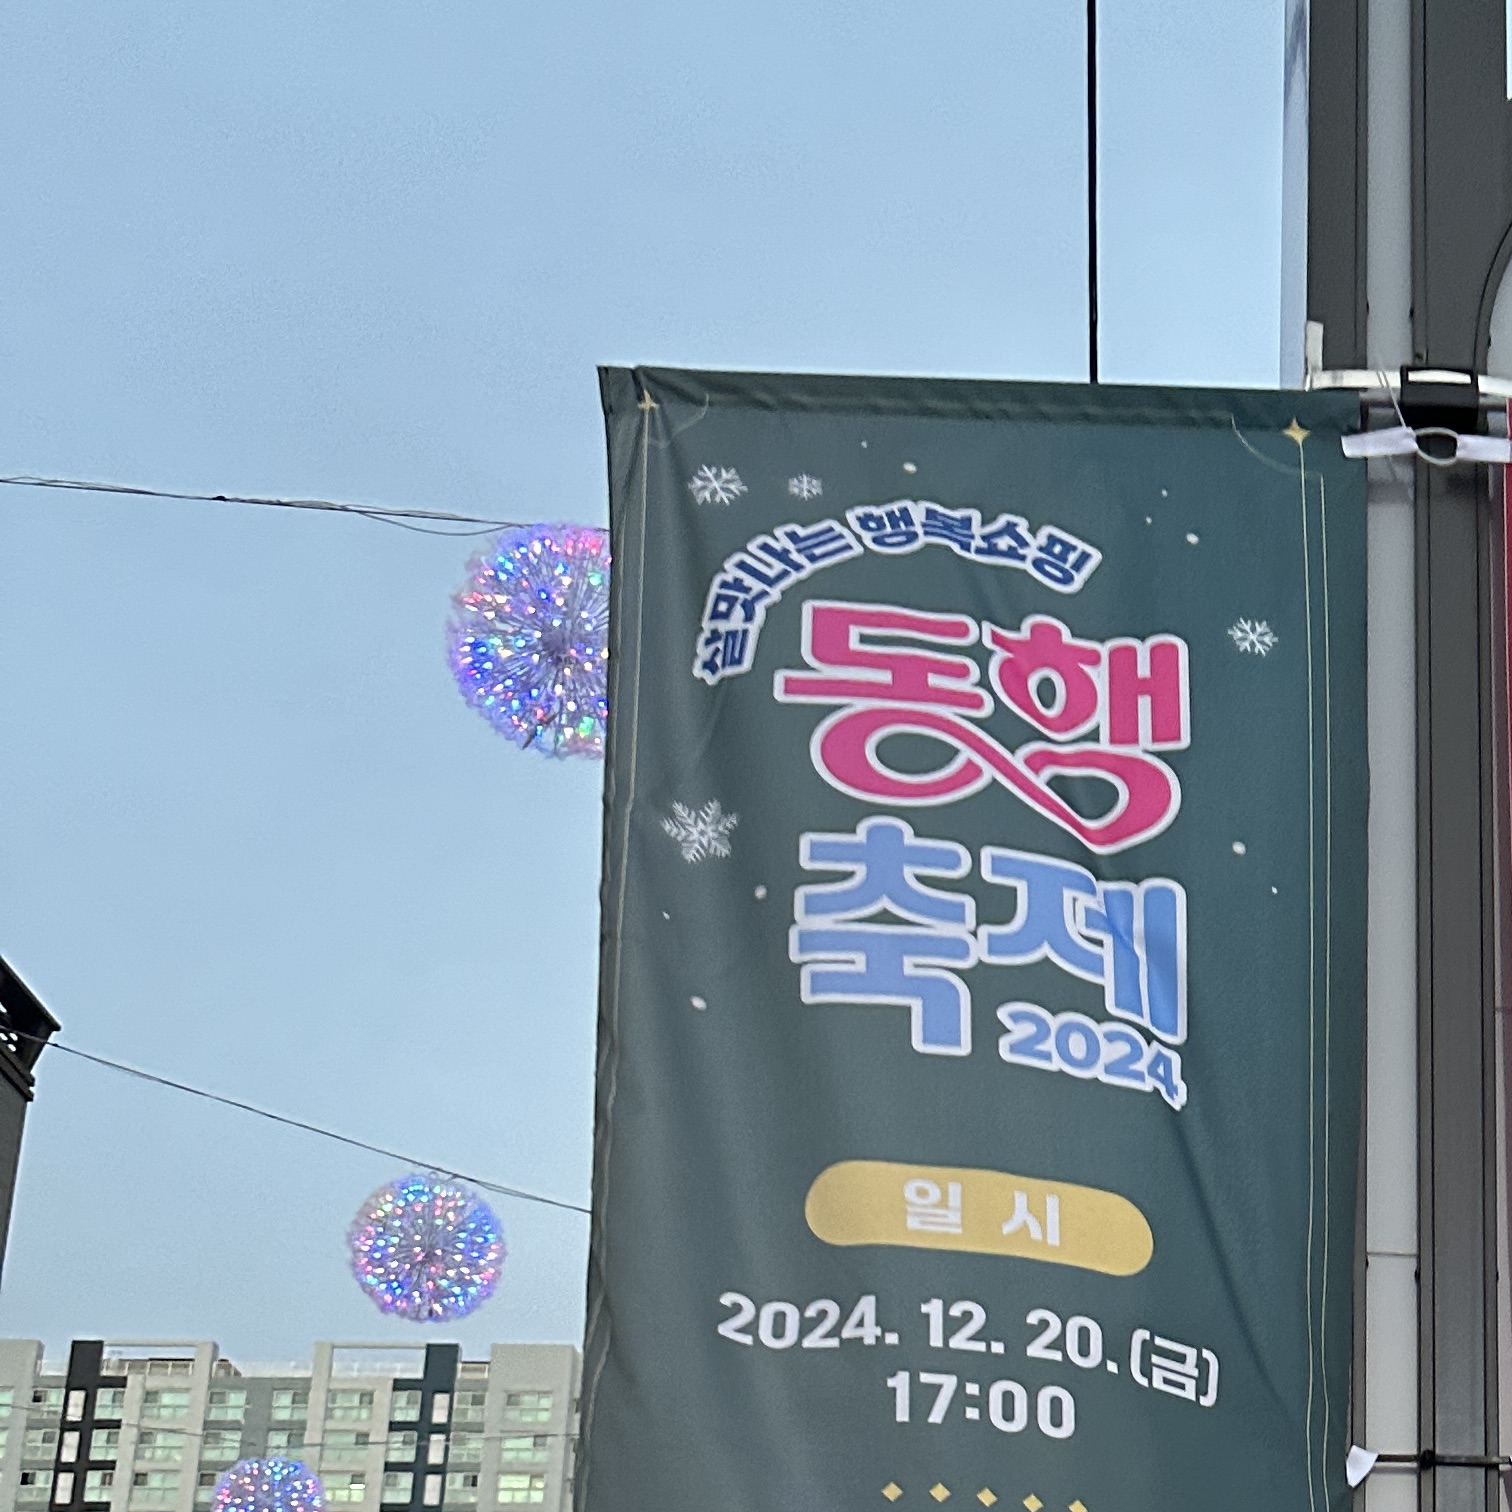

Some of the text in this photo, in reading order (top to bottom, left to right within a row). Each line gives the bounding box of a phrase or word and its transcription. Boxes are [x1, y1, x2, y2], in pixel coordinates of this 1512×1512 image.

[693, 500, 1102, 685] 살맛나는 행복쇼핑
[774, 599, 1189, 854] 동행
[789, 815, 1188, 1056] 축제
[997, 1003, 1186, 1108] 2024
[716, 1292, 899, 1350] 2024.
[920, 1298, 1005, 1354] 12.
[886, 1371, 1076, 1439] 17:00
